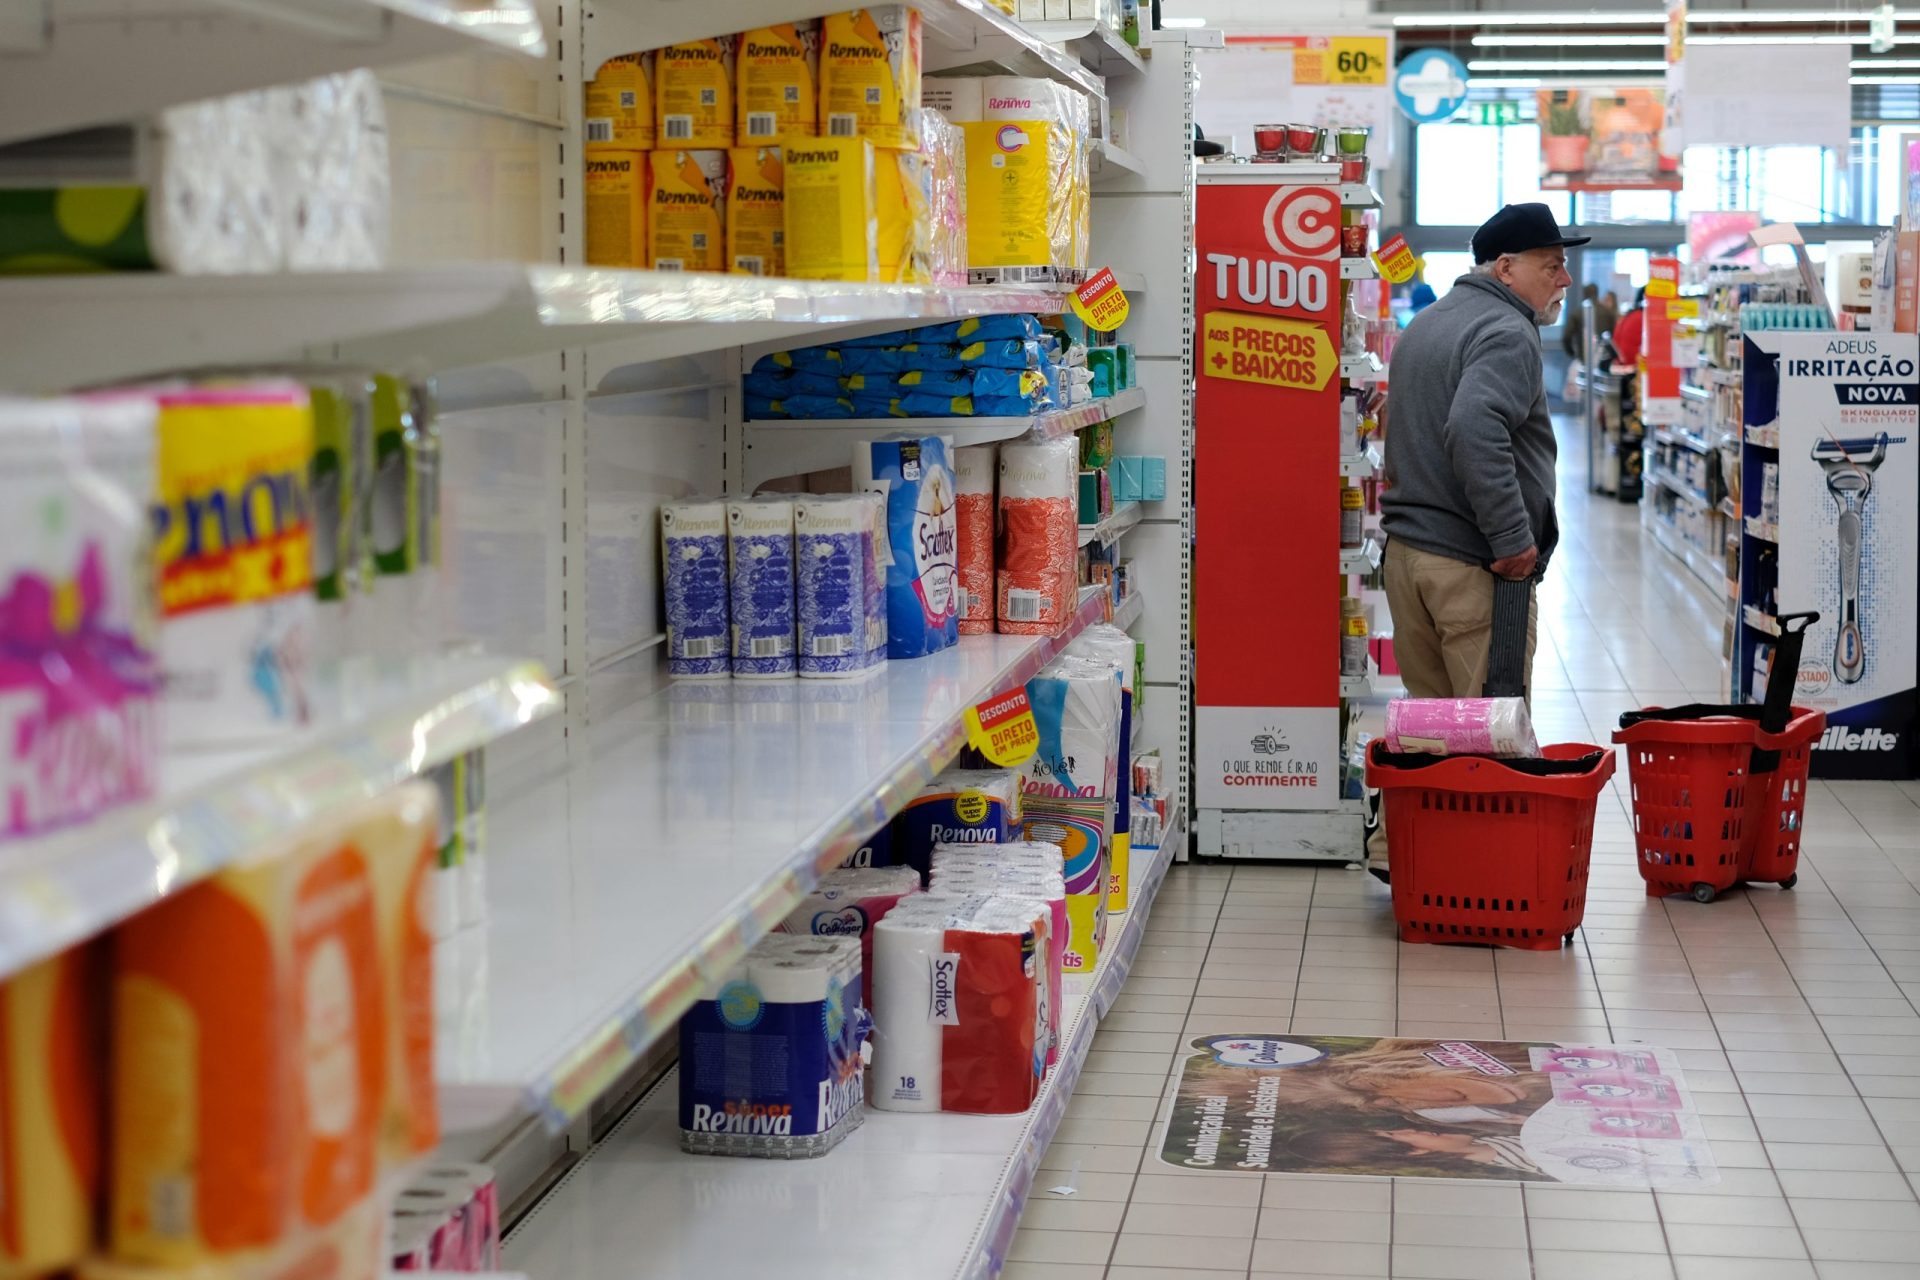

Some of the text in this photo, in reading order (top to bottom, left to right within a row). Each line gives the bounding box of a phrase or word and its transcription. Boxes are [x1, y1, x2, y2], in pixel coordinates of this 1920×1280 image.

[988, 98, 1031, 110] Renova
[586, 160, 631, 173] enova
[787, 149, 839, 164] Renova
[736, 186, 784, 202] Renov
[1079, 273, 1113, 302] DESCONTO
[1206, 253, 1328, 312] TUDO
[1091, 291, 1122, 319] DIRETO
[1096, 315, 1107, 325] EM
[1107, 300, 1127, 318] PREÇO
[1208, 326, 1317, 358] AOS PREÇOS
[1826, 340, 1877, 354] ADEUS
[1231, 351, 1317, 386] BAIXOS
[1788, 355, 1914, 382] IRRITAÇÃO
[1848, 386, 1906, 402] NOVA
[1797, 671, 1828, 683] ESTADO
[979, 693, 1026, 722] DESCONTO
[991, 718, 1033, 747] DIRETO
[994, 731, 1036, 757] EM PREÇO
[1811, 725, 1896, 752] illette
[1223, 758, 1318, 774] O QUE RENDE É IR AO
[1223, 775, 1318, 787] CONTINENTE
[930, 823, 997, 844] Renova
[1062, 951, 1082, 968] tis
[935, 959, 953, 1020] Scottex
[900, 1076, 916, 1089] 18
[1245, 1076, 1281, 1118] Resistência
[692, 1103, 792, 1136] Renova
[1184, 1095, 1232, 1166] Combinação ideal
[1236, 1124, 1275, 1169] Suavidade
